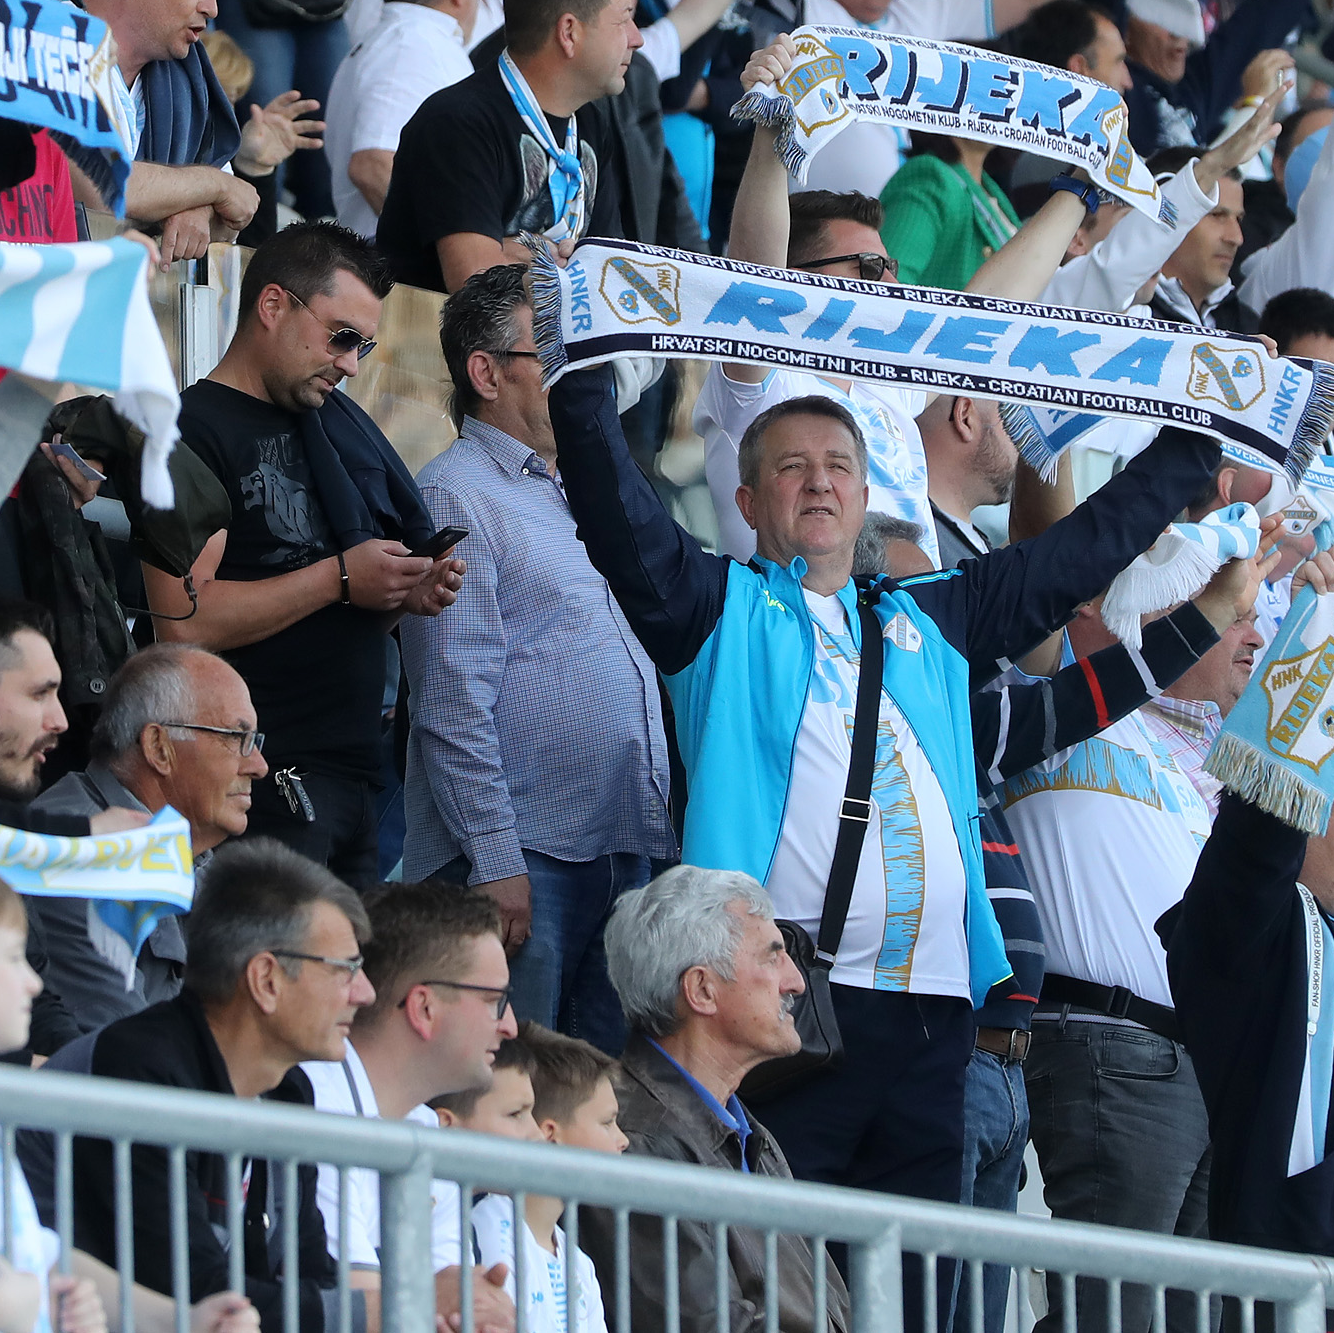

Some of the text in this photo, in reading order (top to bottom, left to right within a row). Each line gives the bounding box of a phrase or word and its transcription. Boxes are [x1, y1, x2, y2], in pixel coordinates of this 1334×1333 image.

[788, 58, 841, 100] RIJEKA
[986, 52, 1037, 72] CROATIAN
[1037, 63, 1089, 84] FOOTBALL
[825, 36, 1122, 159] RIJEKA
[882, 106, 938, 125] NOGOMETNI
[938, 114, 962, 129] KLUB
[967, 118, 998, 137] RIJEKA
[1003, 125, 1046, 147] CROATIAN
[1046, 136, 1088, 161] FOOTBALL
[1104, 109, 1124, 132] HNK
[564, 260, 593, 335] HNKR
[636, 241, 729, 269] HRVATSKI
[730, 260, 841, 290] NOGOMETNI
[841, 277, 891, 298] KLUB
[903, 287, 969, 307] RIJEKA
[982, 299, 1077, 321] CROATIAN
[1079, 309, 1176, 335] FOOTBALL
[656, 268, 673, 293] HNK
[703, 279, 1176, 388] RIJEKA
[651, 335, 1213, 428] HRVATSKI NOGOMETNI KLUB RIJEKA CROATIAN FOOTBALL CLUB
[1193, 370, 1211, 395] HNK
[1266, 364, 1304, 437] HNKR
[1271, 661, 1305, 692] HNK
[1313, 917, 1323, 949] OFFICIAL
[1313, 948, 1323, 970] HNKR
[1311, 970, 1323, 1008] FAN-SHOP
